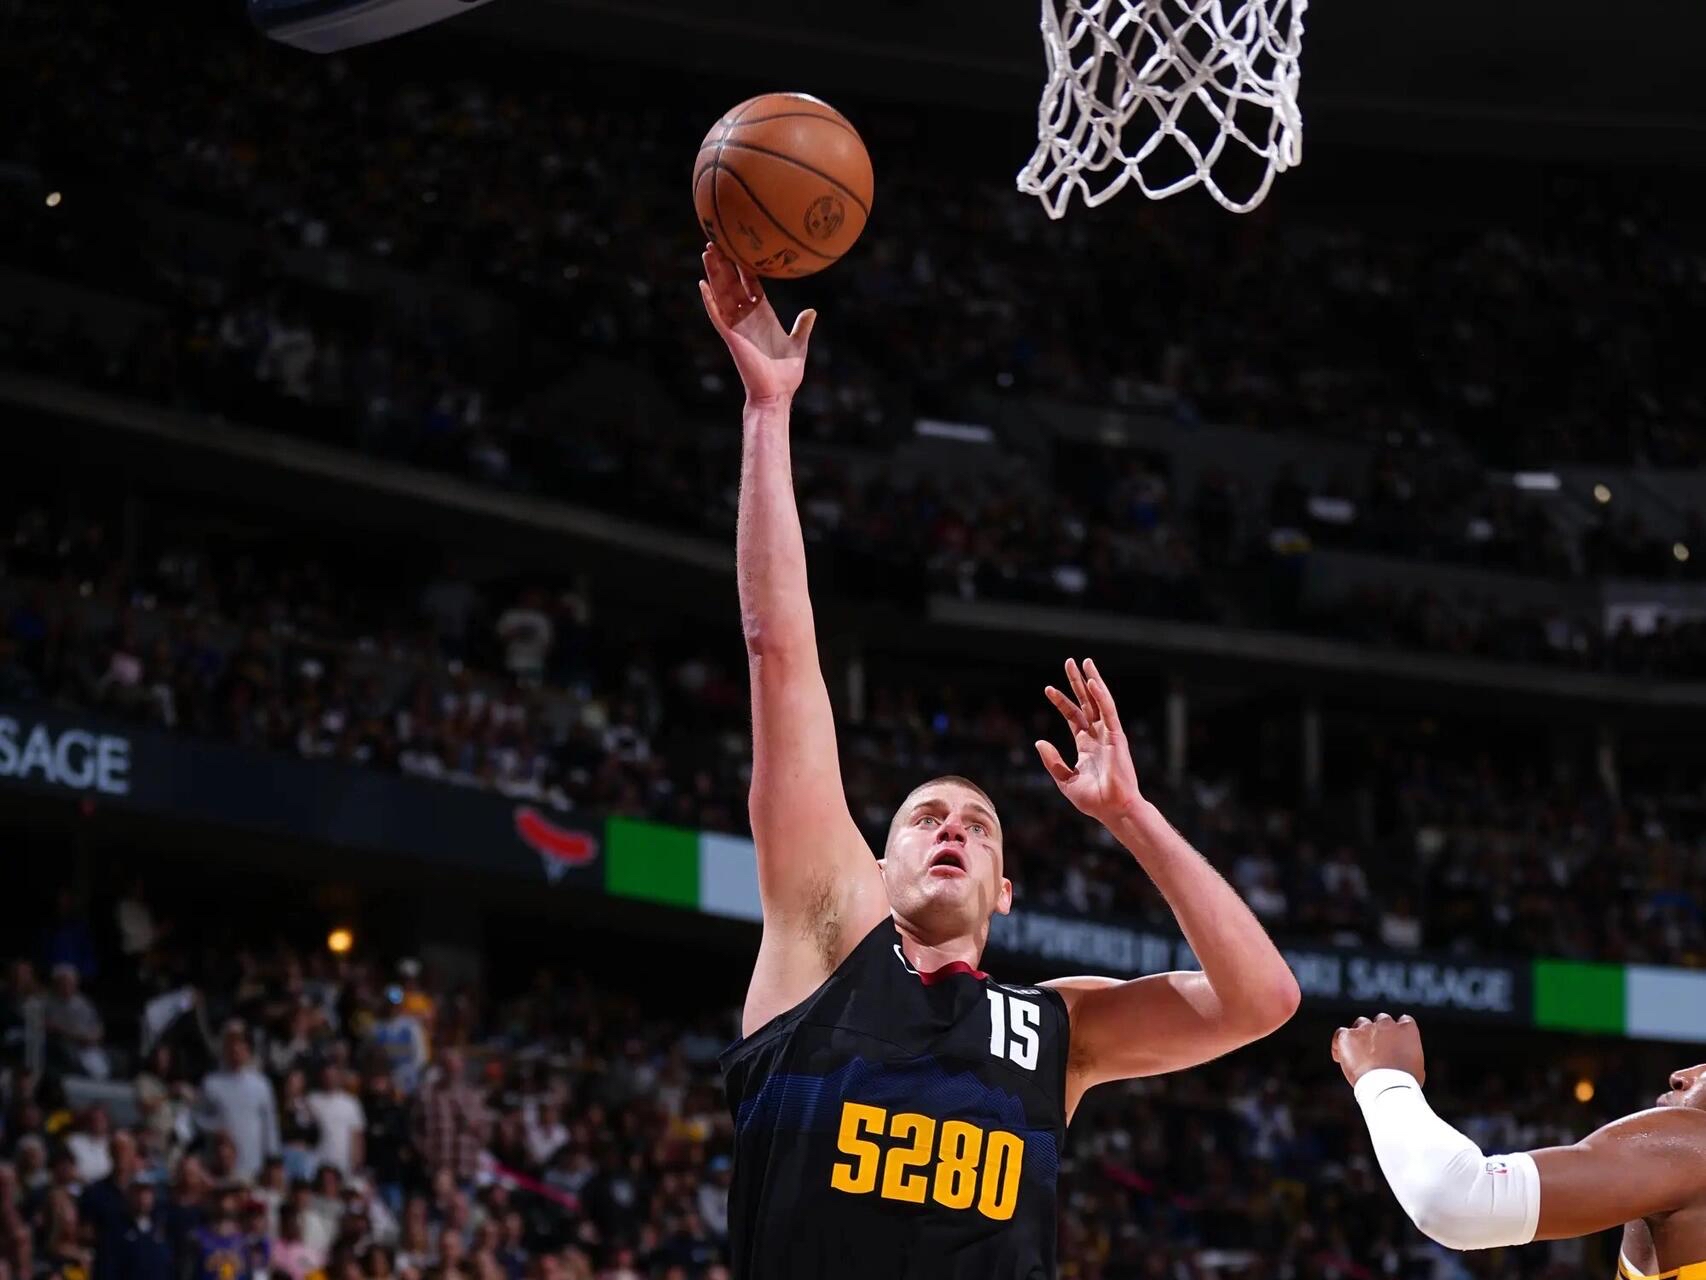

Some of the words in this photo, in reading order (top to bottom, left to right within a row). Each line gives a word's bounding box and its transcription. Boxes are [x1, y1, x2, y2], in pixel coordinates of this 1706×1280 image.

[1350, 957, 1512, 1011] SAUSAGE
[986, 988, 1040, 1070] 15
[831, 1101, 1024, 1221] 5280
